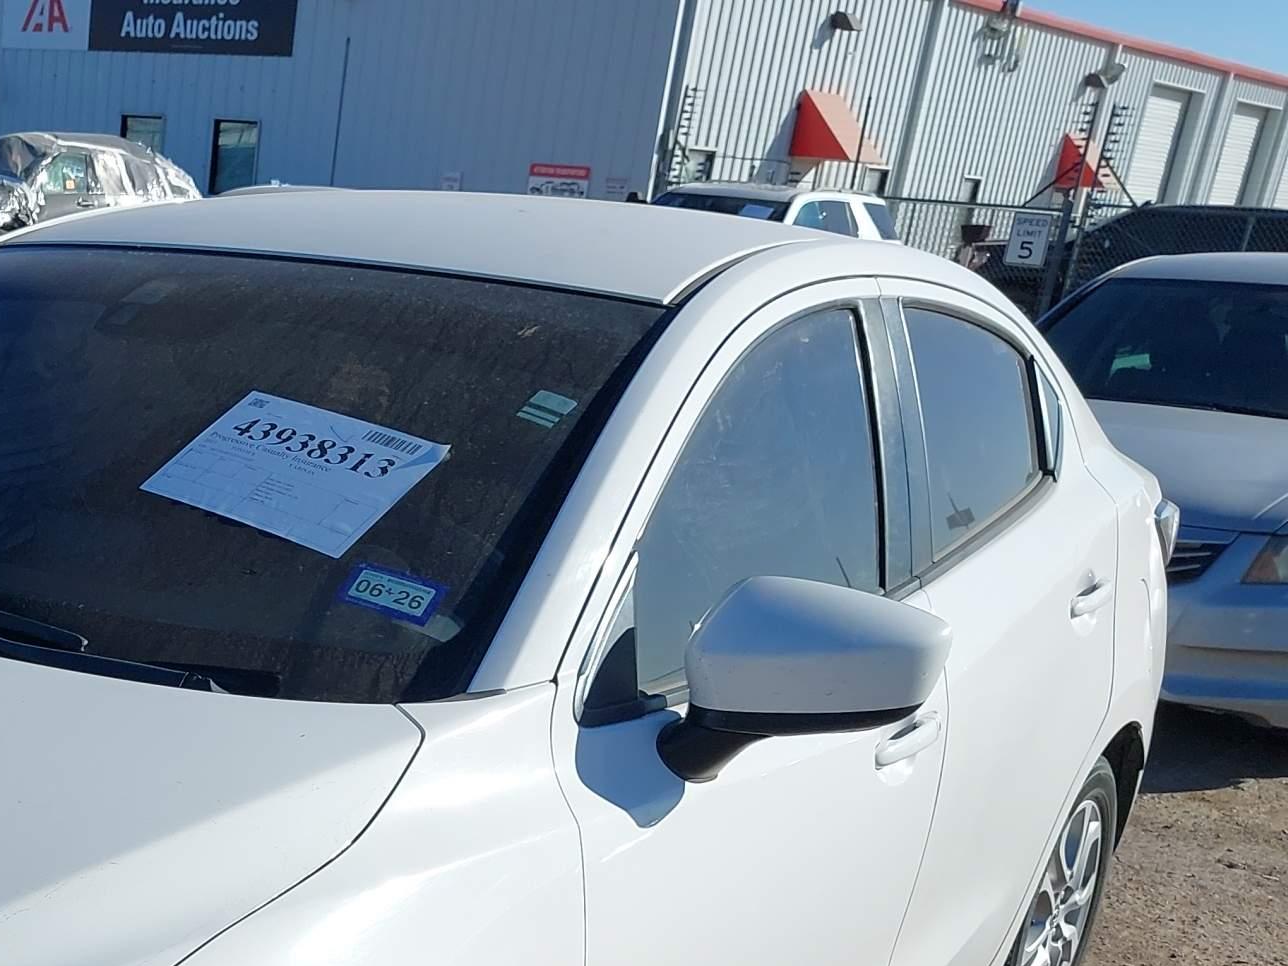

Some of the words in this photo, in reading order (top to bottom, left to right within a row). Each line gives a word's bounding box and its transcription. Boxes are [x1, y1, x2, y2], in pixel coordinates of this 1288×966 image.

[120, 10, 166, 39] Auto
[170, 11, 259, 41] Auctions
[1016, 217, 1049, 228] SPEED
[1016, 229, 1043, 239] LIMIT
[1017, 241, 1034, 259] 5
[232, 418, 396, 479] 43938313
[355, 579, 386, 597] 06
[392, 590, 425, 610] 26
